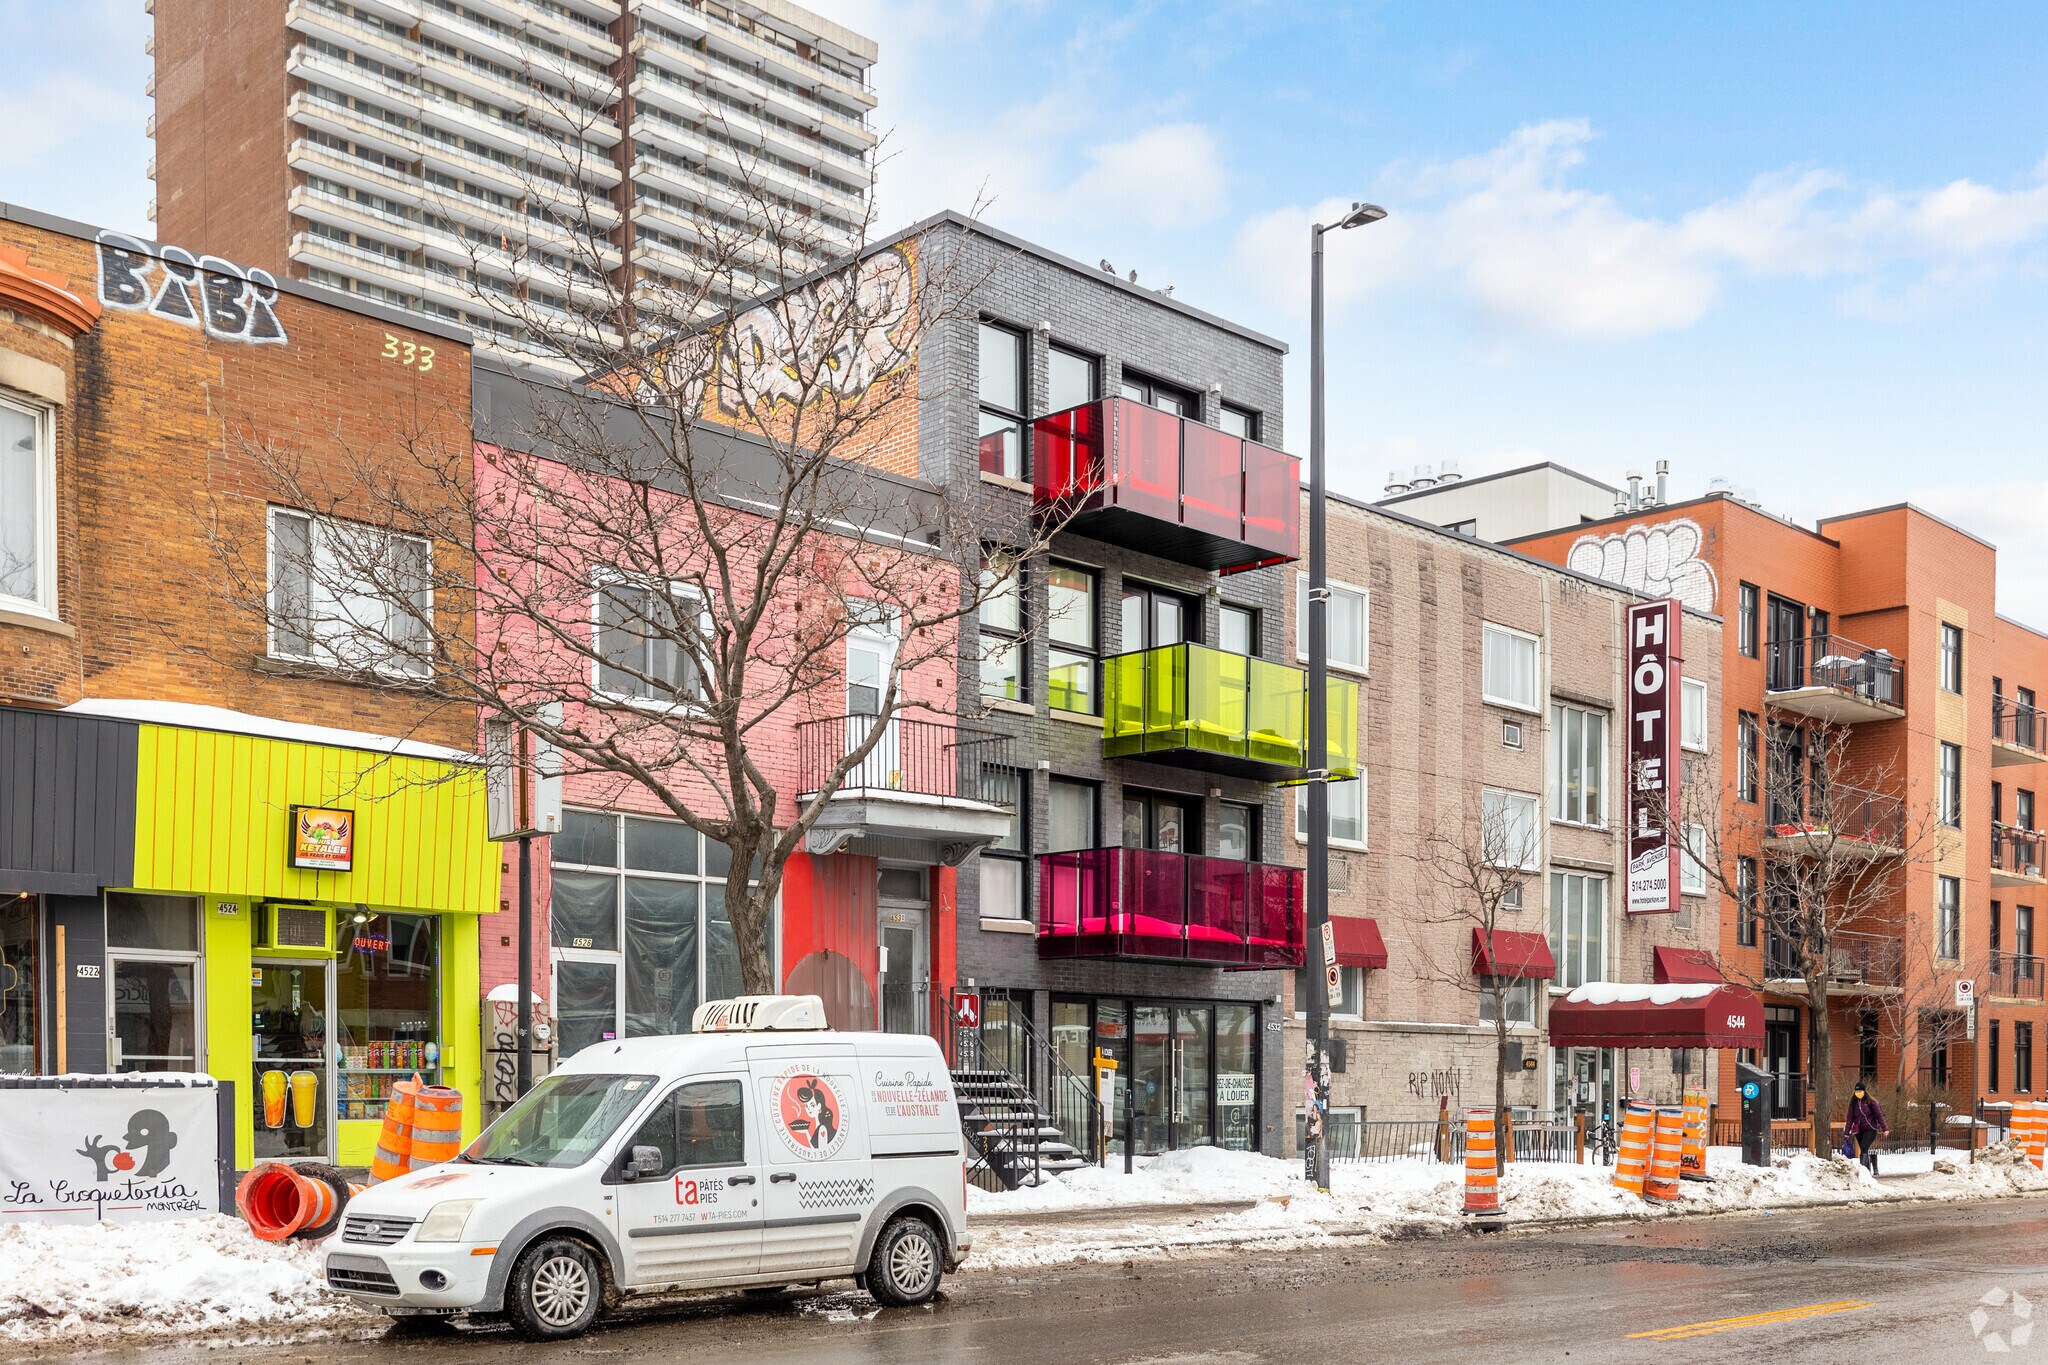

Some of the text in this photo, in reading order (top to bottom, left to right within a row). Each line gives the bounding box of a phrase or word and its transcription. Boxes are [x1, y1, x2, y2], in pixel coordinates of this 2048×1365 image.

[382, 332, 435, 371] 333
[1634, 613, 1663, 839] HÔTEL
[300, 843, 348, 854] KETALEE
[1632, 851, 1664, 870] PARK AVENUE
[1632, 878, 1667, 892] 514.274.5000
[219, 904, 237, 913] 4524
[354, 937, 391, 952] OUVERT
[78, 967, 99, 976] 4522
[1267, 1022, 1281, 1031] 4532
[1726, 1014, 1746, 1029] 4544
[875, 1070, 933, 1093] Cuisine Rapide
[1408, 1071, 1428, 1099] RIP
[772, 1085, 781, 1124] CUISINE
[777, 1064, 800, 1085] RAPIDE
[801, 1064, 810, 1072] DE
[876, 1088, 949, 1103] NOUVELLE-ZÉLANDE
[1227, 1090, 1249, 1101] LOUER
[896, 1104, 940, 1117] L'AUSTRALIE
[4, 1180, 44, 1205] La
[675, 1175, 699, 1205] ta
[699, 1179, 724, 1191] PÂTÉS
[700, 1193, 718, 1204] PIES
[669, 1213, 680, 1223] 277
[681, 1212, 696, 1222] 7437
